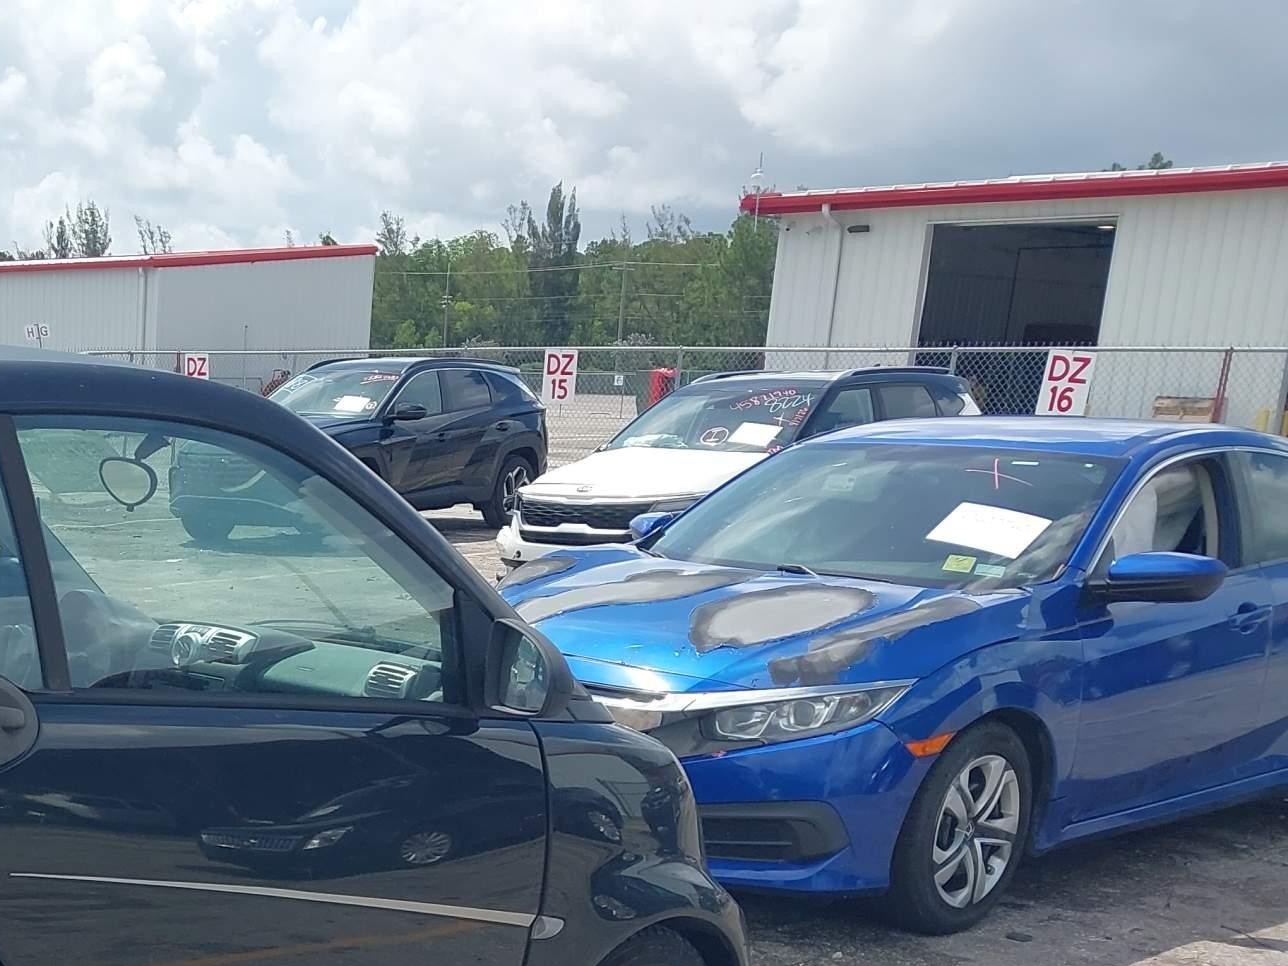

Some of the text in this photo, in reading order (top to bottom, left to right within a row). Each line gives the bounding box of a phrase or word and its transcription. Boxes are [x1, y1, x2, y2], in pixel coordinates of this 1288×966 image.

[187, 357, 207, 377] DZ
[546, 353, 575, 376] DZ
[1047, 355, 1092, 385] DZ
[551, 378, 568, 400] 15
[1047, 385, 1075, 413] 16
